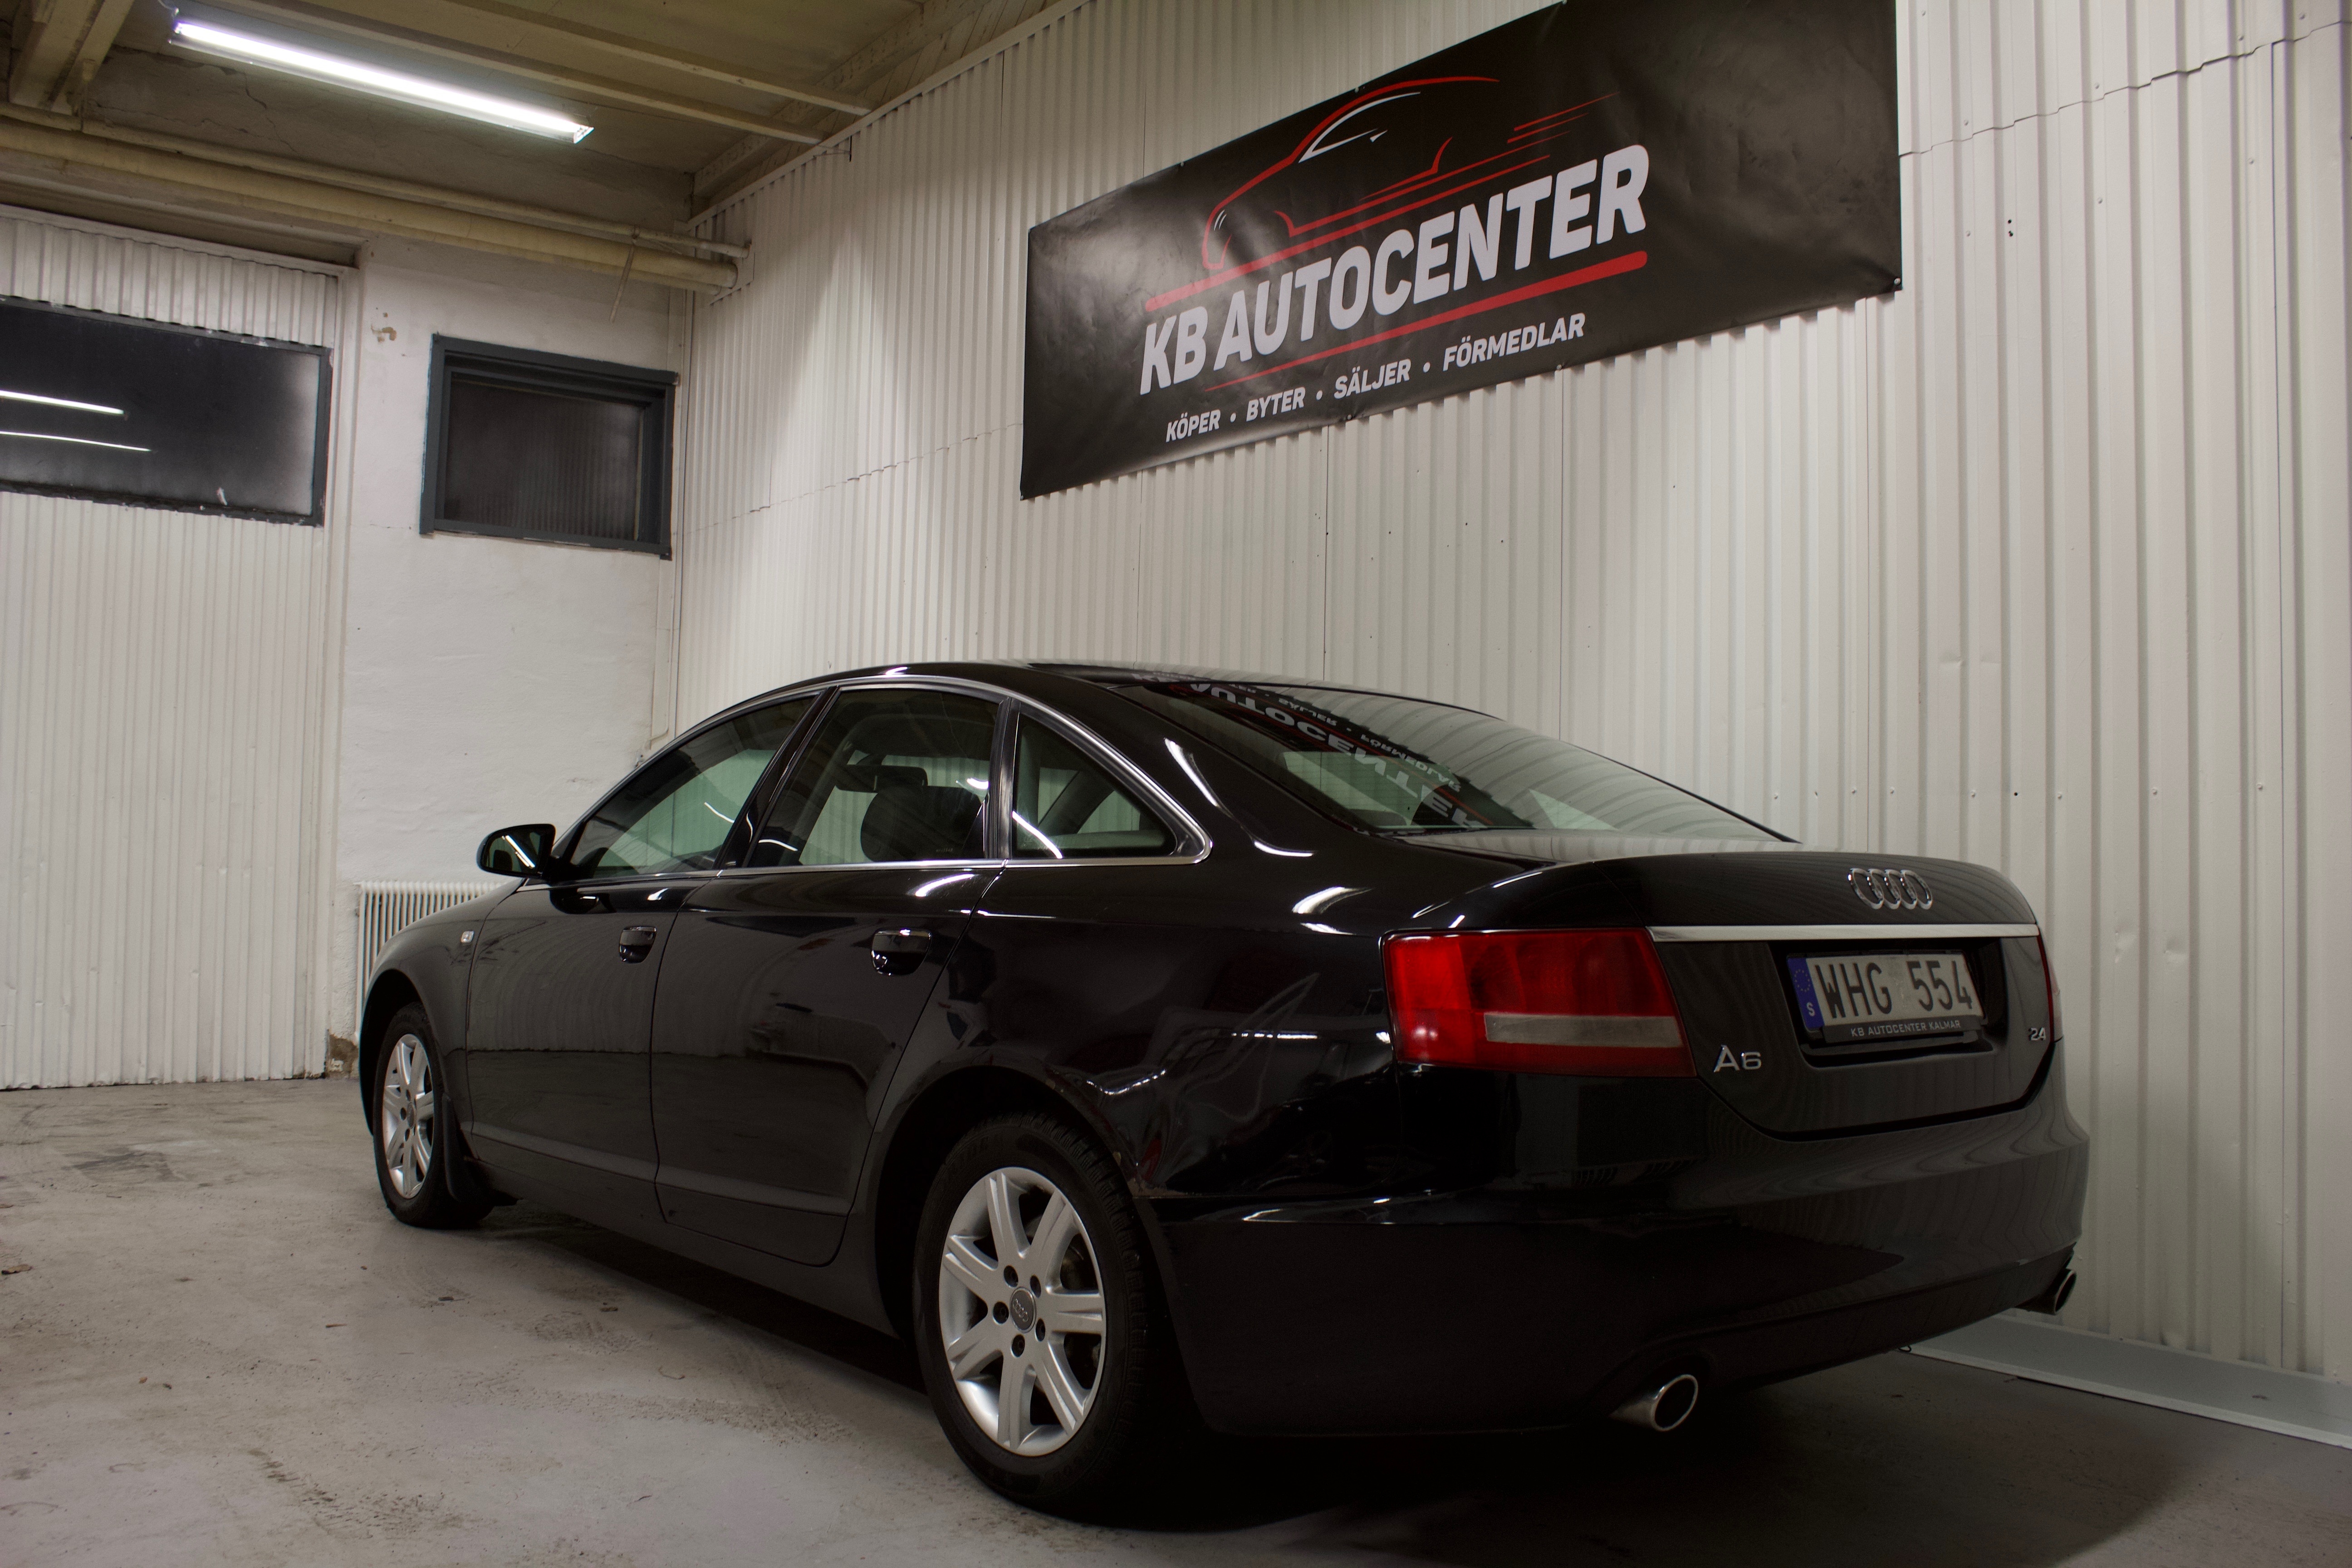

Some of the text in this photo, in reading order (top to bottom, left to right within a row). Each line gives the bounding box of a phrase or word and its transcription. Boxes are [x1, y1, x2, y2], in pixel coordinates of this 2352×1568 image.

[1140, 145, 1649, 395] KB AUTOCENTER
[1166, 313, 1585, 442] KÖPER BYTER SÄLJER FÖRMEDLAR
[1806, 1002, 1815, 1017] S
[1815, 960, 1972, 1019] WHG 554
[1851, 1020, 1961, 1037] KB AUTOCENTER KALMAR
[1713, 1044, 1761, 1072] A6
